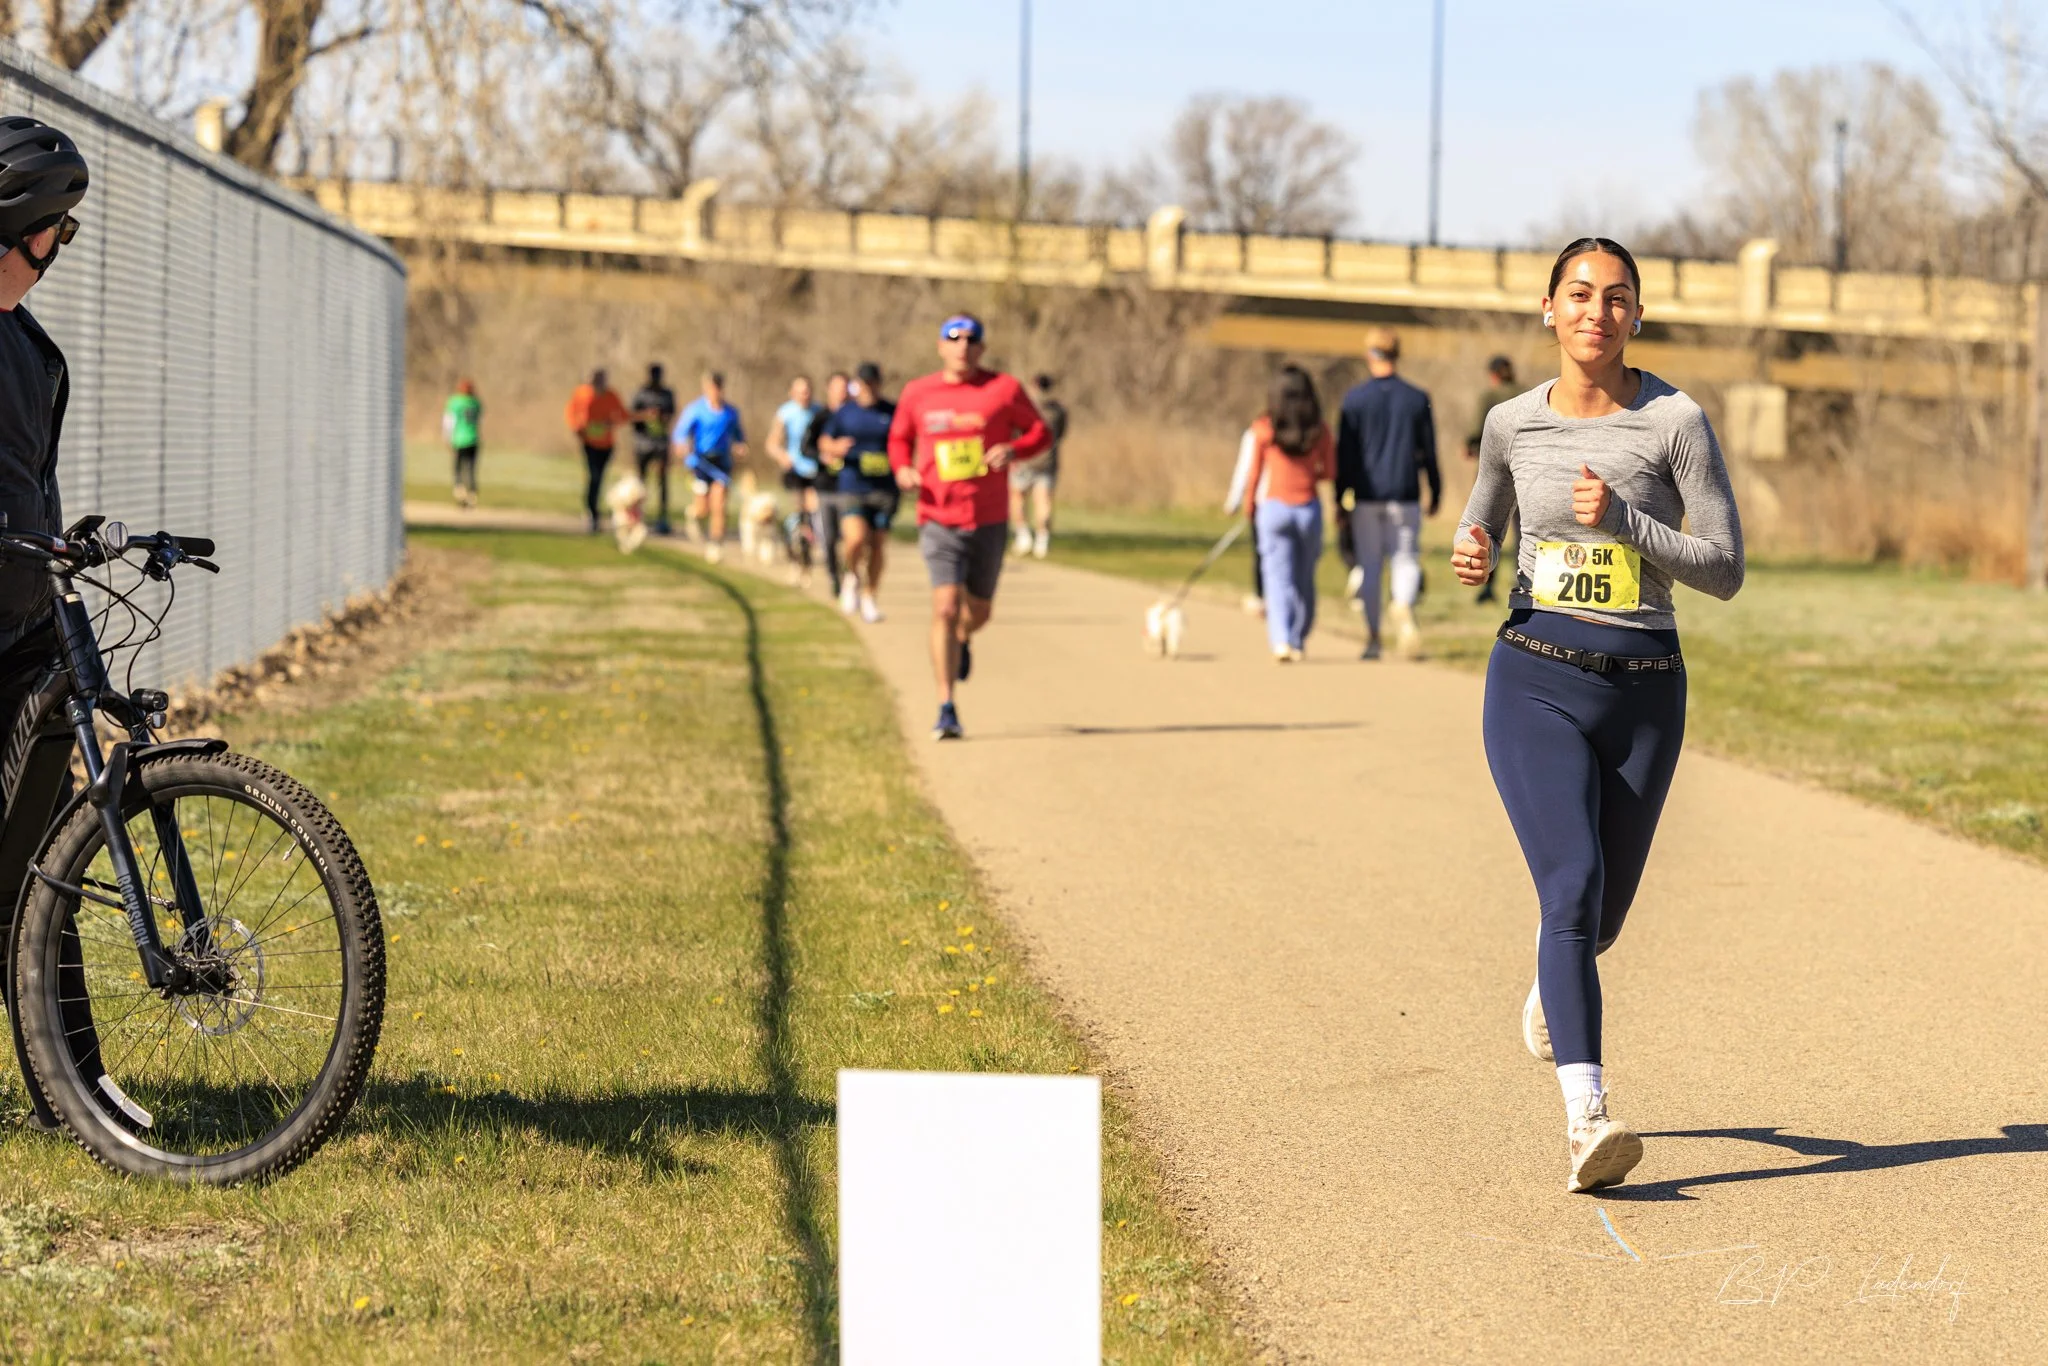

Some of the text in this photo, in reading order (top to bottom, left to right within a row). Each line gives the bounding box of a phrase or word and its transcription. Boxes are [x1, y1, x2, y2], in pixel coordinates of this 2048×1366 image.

[1592, 548, 1614, 566] 5K
[1557, 572, 1612, 604] 205
[1504, 629, 1576, 660] SPIBELT
[244, 784, 330, 875] GROUND CONTROL
[117, 873, 150, 948] ROCKSHOX
